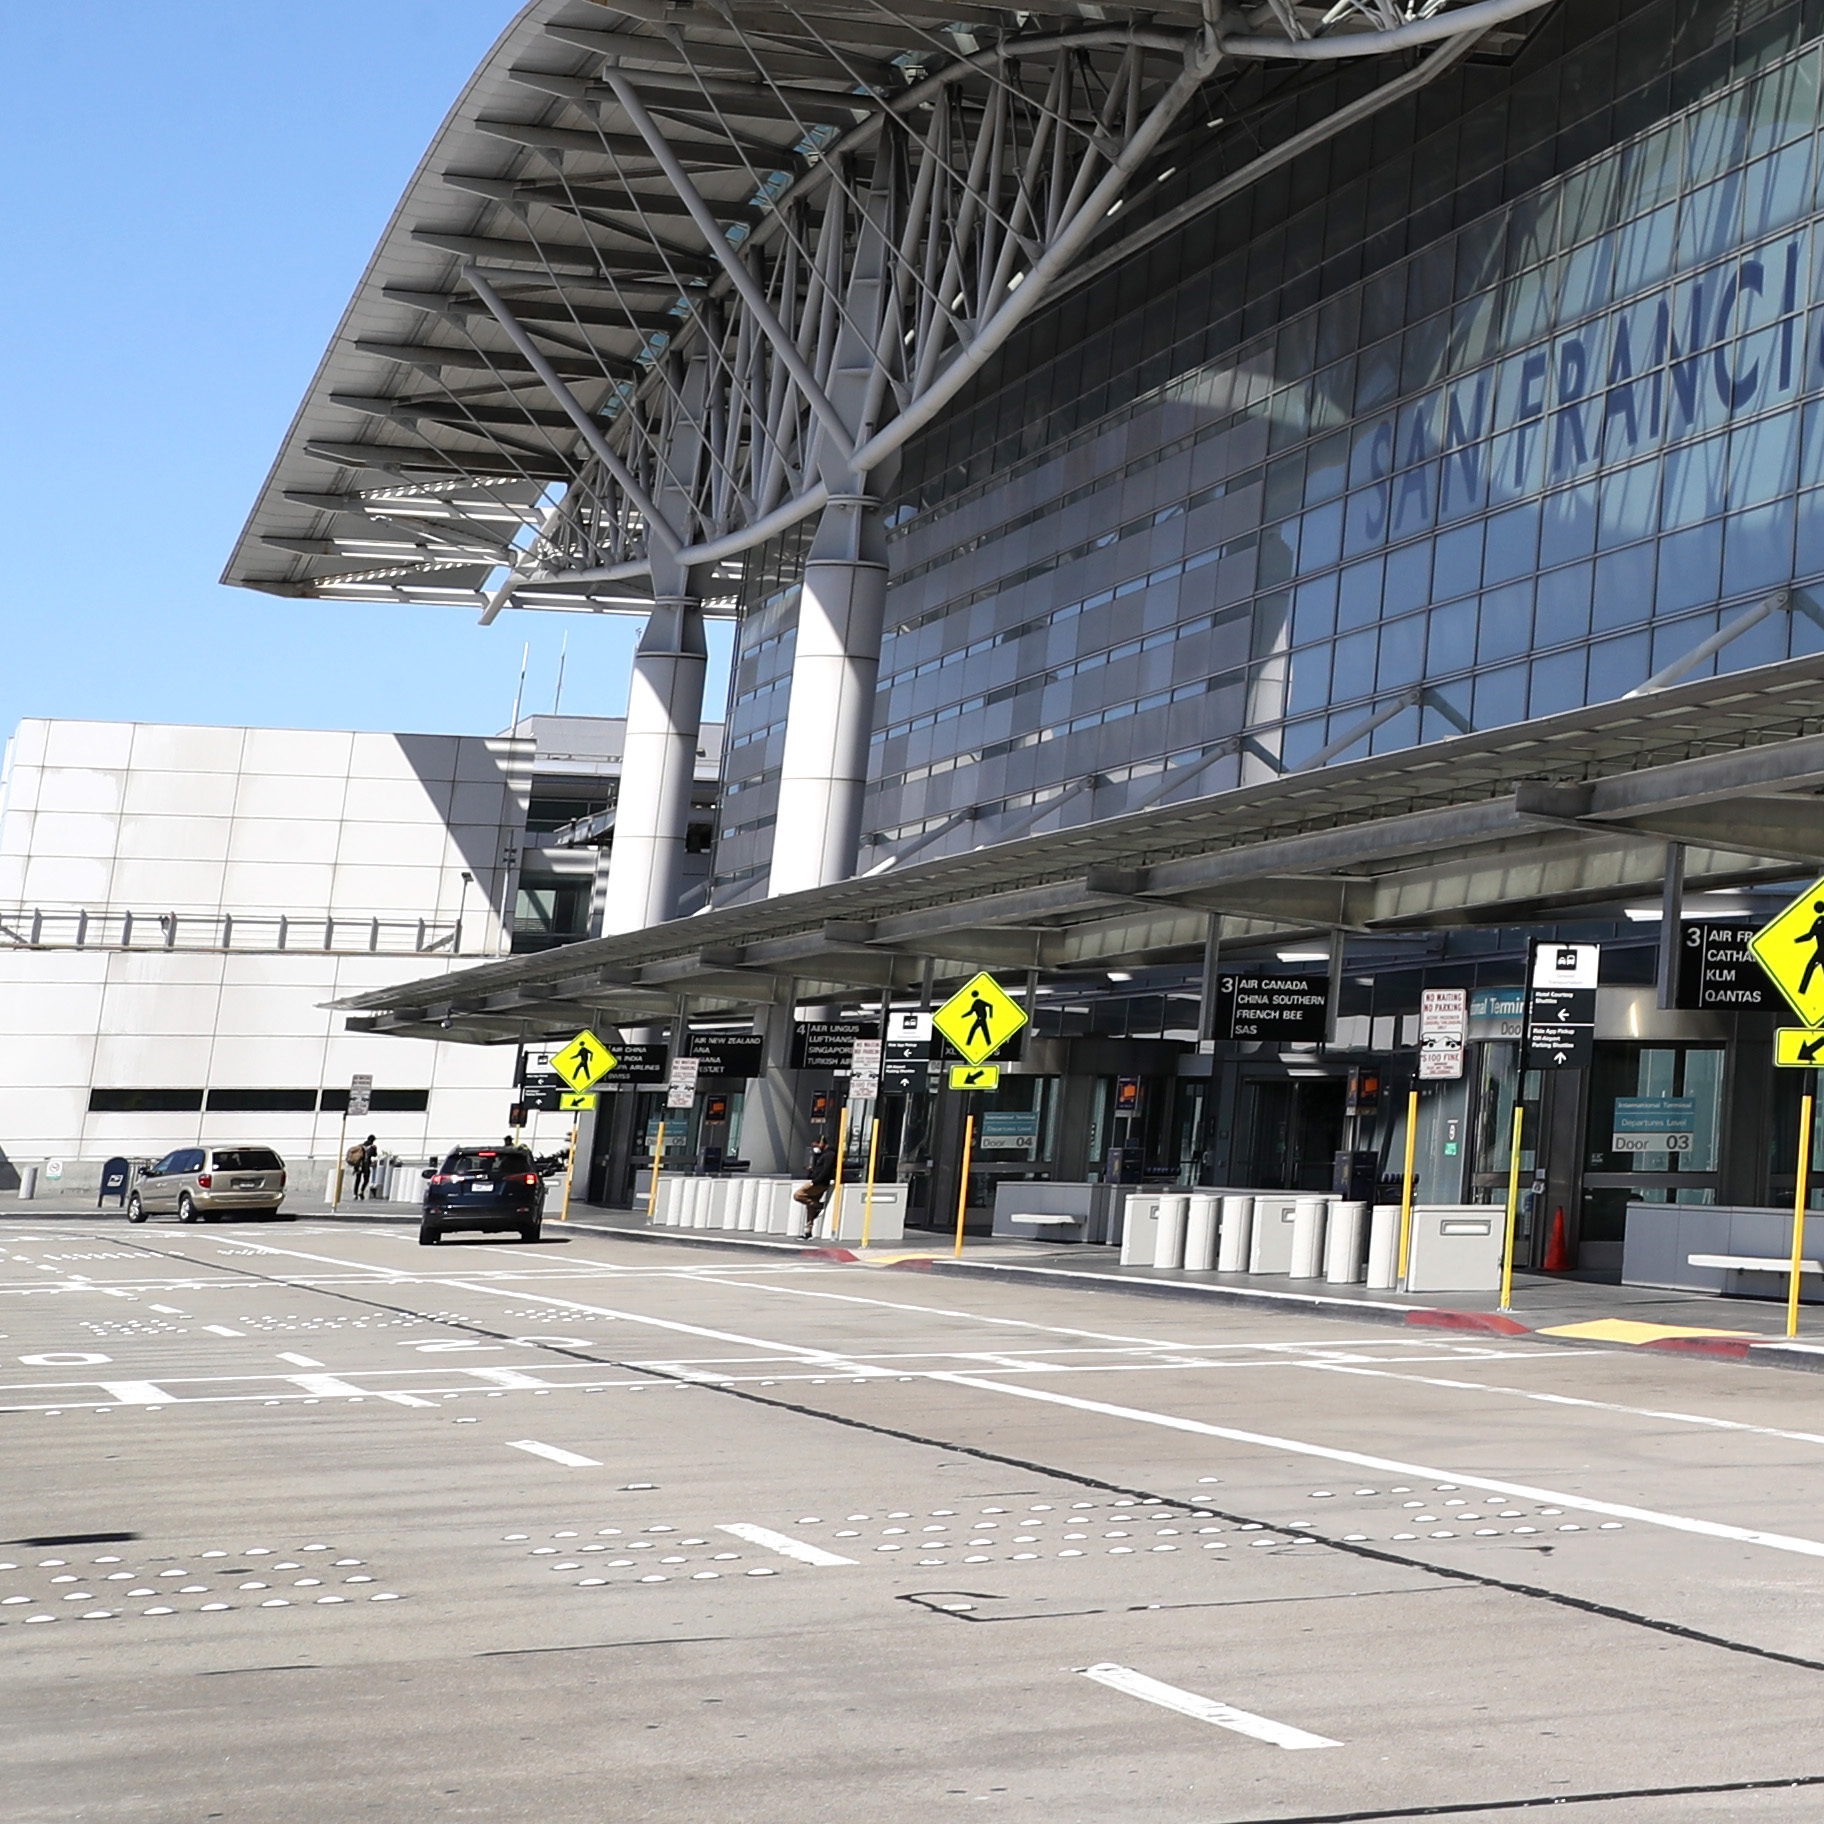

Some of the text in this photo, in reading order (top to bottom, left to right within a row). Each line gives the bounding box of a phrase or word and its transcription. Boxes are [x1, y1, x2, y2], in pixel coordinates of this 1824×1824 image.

[1363, 379, 1486, 541] SAN
[1686, 927, 1701, 947] 3
[1708, 929, 1732, 942] AIR
[1705, 969, 1736, 982] KLM
[1221, 977, 1233, 993] 3
[1239, 980, 1308, 990] AIR CANADA
[1238, 995, 1325, 1005] CHINA SOUTHERN
[1426, 993, 1462, 1002] NO WAITING
[1704, 990, 1762, 1003] QANTAS
[1423, 1003, 1433, 1012] NO
[1435, 1004, 1462, 1012] PARKING
[1236, 1009, 1303, 1020] FRENCH BEE
[796, 1024, 806, 1035] 4
[1235, 1025, 1258, 1034] SAS
[727, 1037, 761, 1045] ZEALAND
[1621, 1119, 1664, 1127] Departures
[983, 1137, 1032, 1147] Door 04
[1615, 1135, 1690, 1150] Door 03
